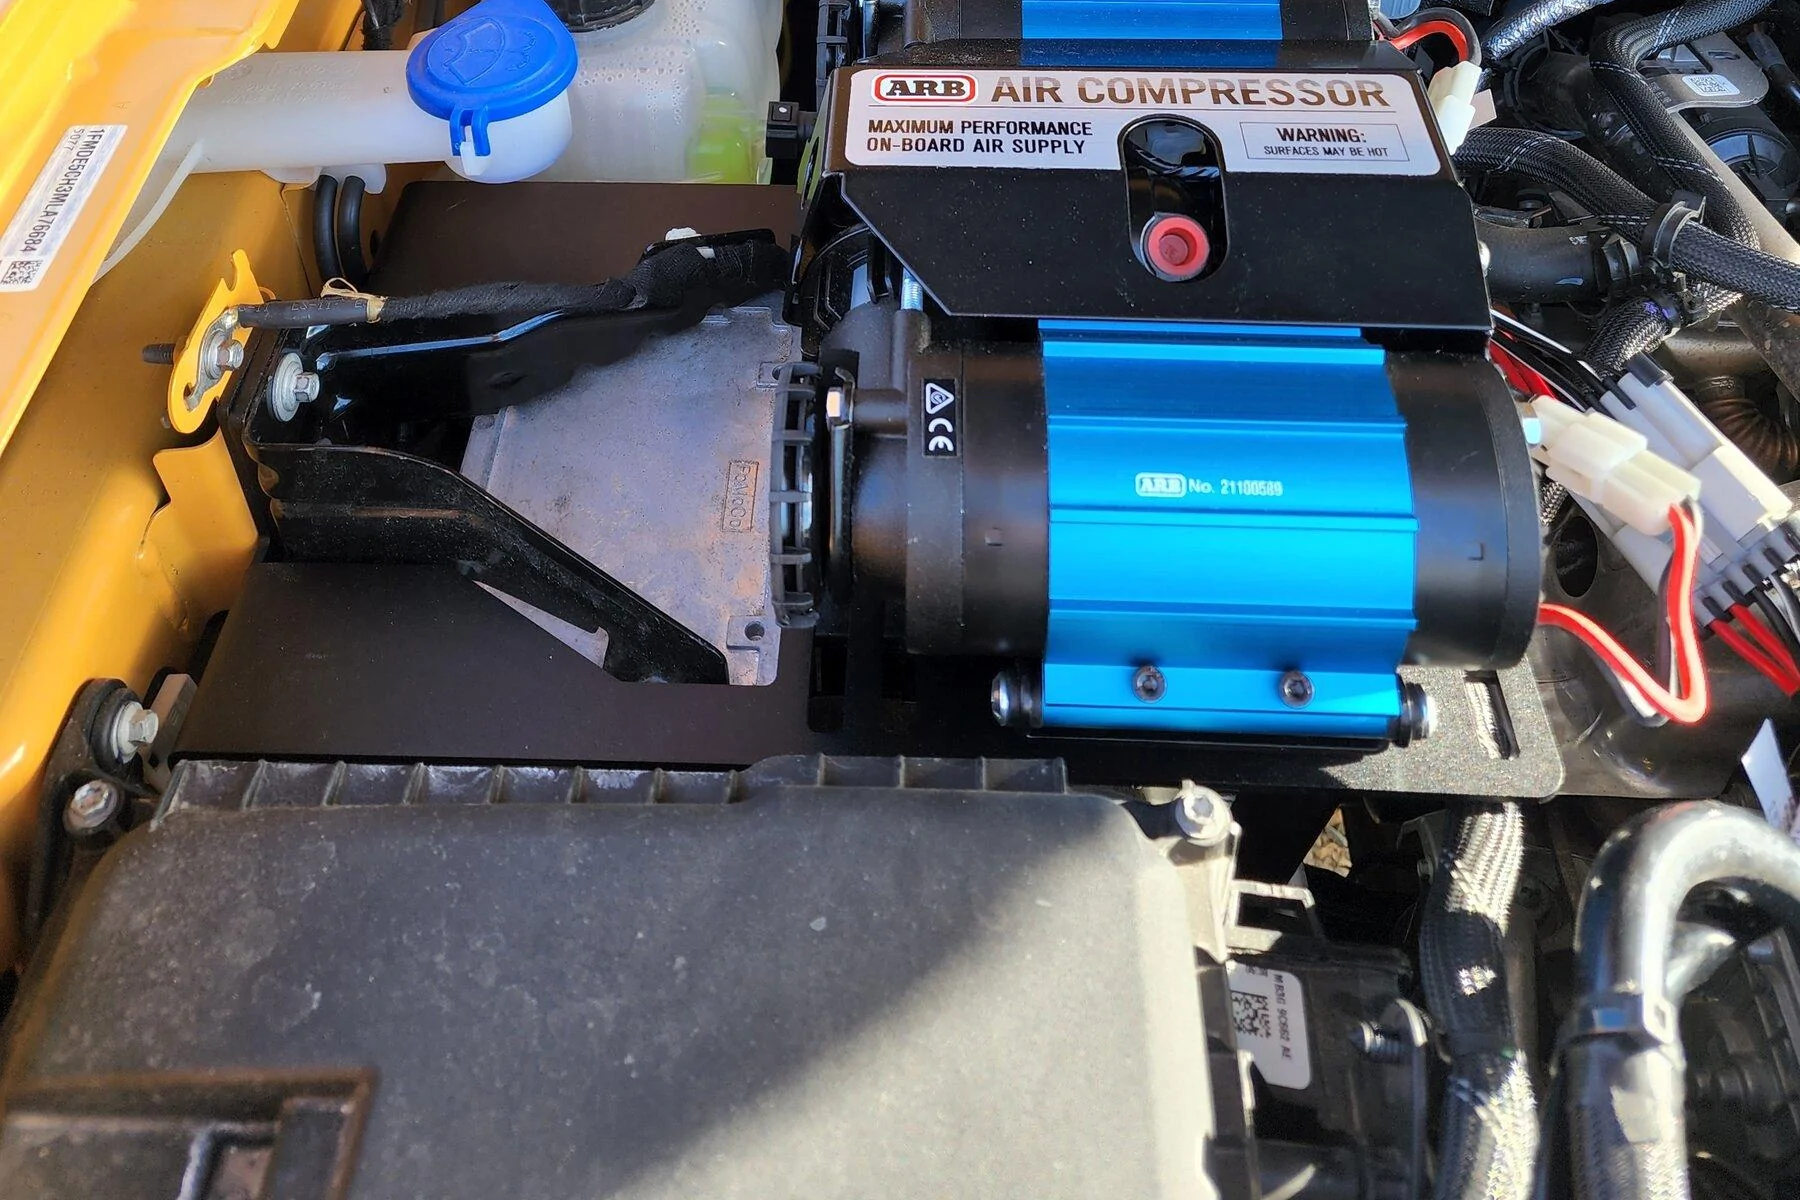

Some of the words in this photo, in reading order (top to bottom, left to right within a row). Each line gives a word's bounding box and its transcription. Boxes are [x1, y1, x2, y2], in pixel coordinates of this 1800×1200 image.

[886, 80, 966, 97] ARB
[991, 76, 1063, 103] AIR
[1077, 77, 1391, 107] COMPRESSOR
[868, 120, 954, 134] MAXIMUM
[961, 120, 1093, 136] PERFORMANCE
[1276, 127, 1367, 144] WARNING:
[867, 137, 965, 153] ON-BOARD
[973, 138, 1004, 153] AIR
[1012, 139, 1086, 154] SUPPLY
[1264, 146, 1320, 156] SURFACES
[1323, 146, 1345, 157] MAY
[1349, 147, 1364, 157] BE
[1367, 147, 1389, 157] HOT
[1188, 479, 1215, 494] No.
